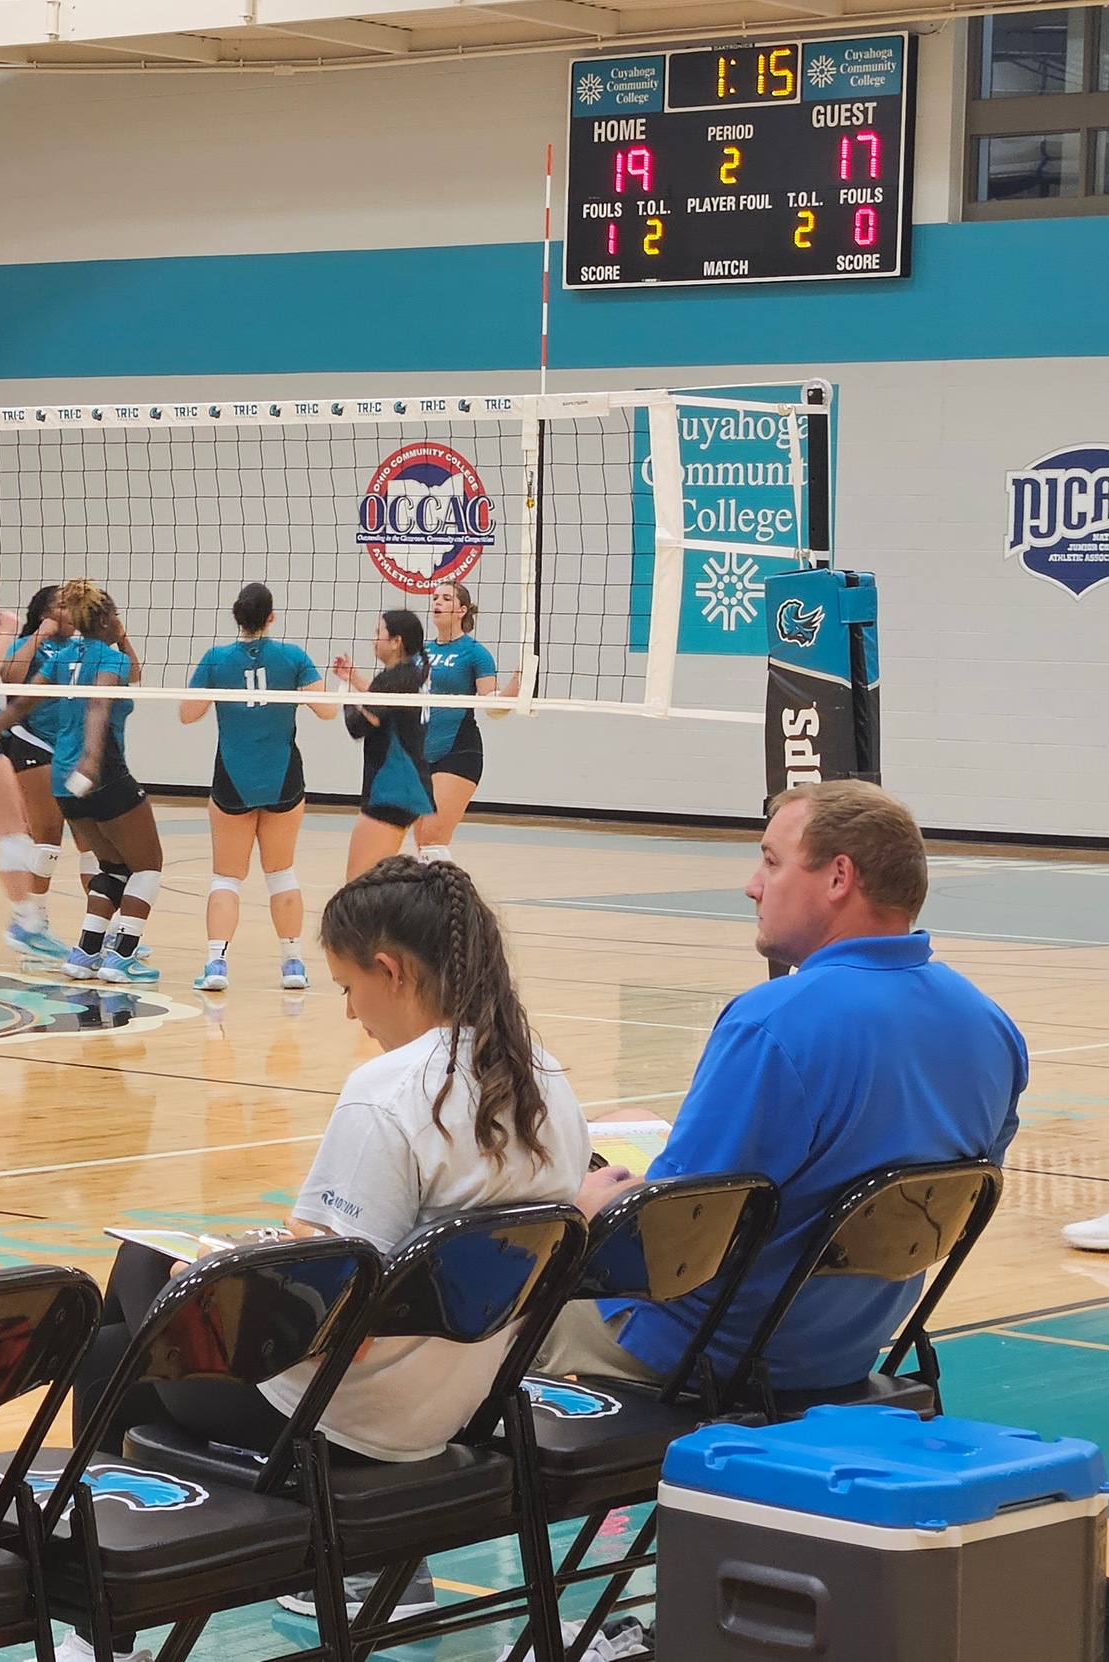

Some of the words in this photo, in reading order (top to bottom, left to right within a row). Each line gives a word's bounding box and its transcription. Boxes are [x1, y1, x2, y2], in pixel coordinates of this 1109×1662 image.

[839, 60, 897, 73] Community
[844, 48, 893, 62] Cuyahoga
[606, 78, 660, 91] Community
[610, 66, 656, 80] Cuyahoga
[717, 48, 793, 98] 1:15
[850, 74, 885, 87] College
[616, 92, 649, 105] College
[812, 102, 877, 128] GUEST
[593, 119, 646, 142] HOME
[707, 125, 754, 141] PERIOD
[719, 146, 740, 184] 2
[839, 131, 880, 180] 17
[614, 146, 651, 193] 19
[637, 200, 671, 216] T.O.L.
[687, 195, 736, 213] PLAYER
[739, 194, 773, 210] FOUL
[787, 191, 824, 208] T.O.L.
[839, 188, 883, 205] FOULS
[583, 202, 622, 218] FOULS
[608, 222, 617, 255] 1
[643, 218, 663, 255] 2
[794, 210, 815, 248] 2
[854, 208, 875, 246] 0
[580, 265, 620, 282] SCORE
[703, 260, 749, 276] MATCH
[836, 254, 880, 271] SCORE
[677, 409, 808, 450] uyahoga
[373, 467, 391, 492] OHIO
[390, 448, 445, 468] COMMUNITY
[445, 454, 479, 492] COLLEGE
[359, 493, 496, 537] OCCAC
[683, 498, 793, 542] College
[373, 548, 414, 586] ATHLETIC
[244, 667, 268, 707] 11
